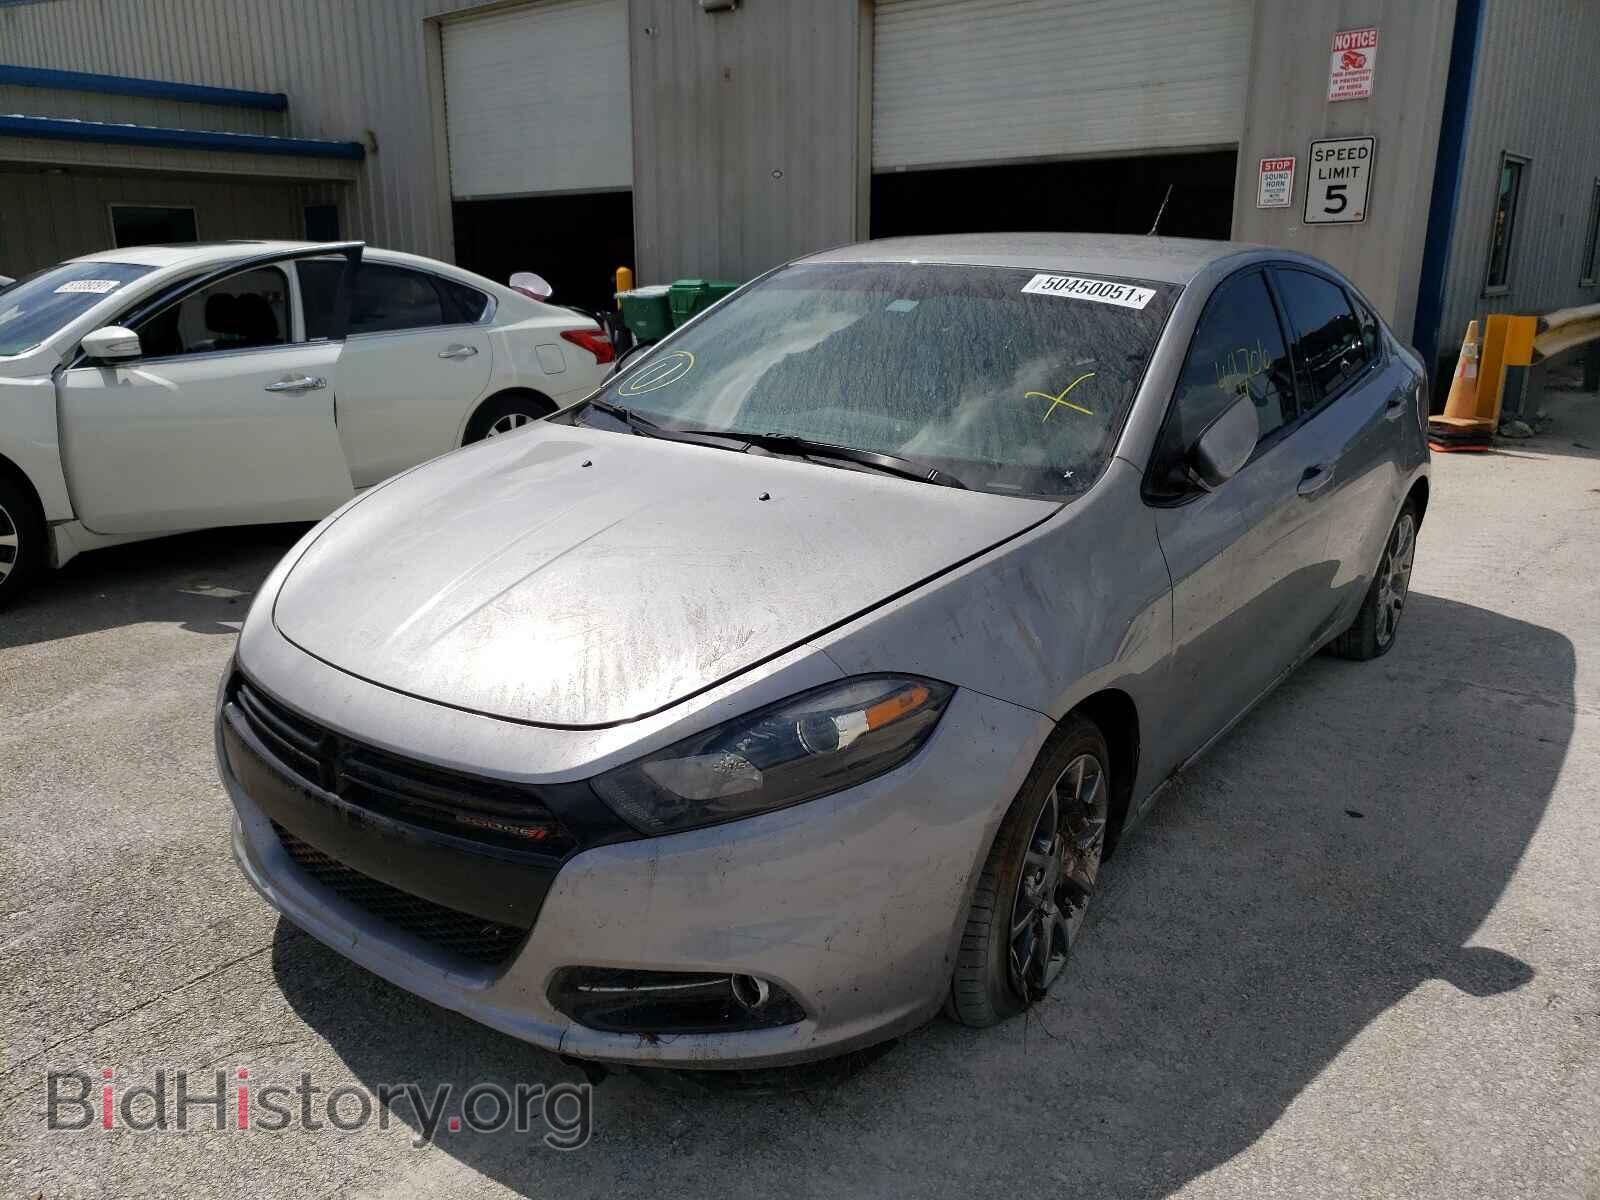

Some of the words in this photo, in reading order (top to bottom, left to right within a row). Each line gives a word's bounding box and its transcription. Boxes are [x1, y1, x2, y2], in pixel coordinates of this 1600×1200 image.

[1334, 31, 1376, 50] NOTICE
[1314, 146, 1369, 162] SPEED
[1265, 161, 1290, 171] STOP
[1318, 166, 1361, 180] LIMIT
[1264, 172, 1288, 181] SOUND
[1265, 180, 1285, 188] HORN
[1323, 184, 1348, 215] 5
[1041, 276, 1137, 302] 50450051
